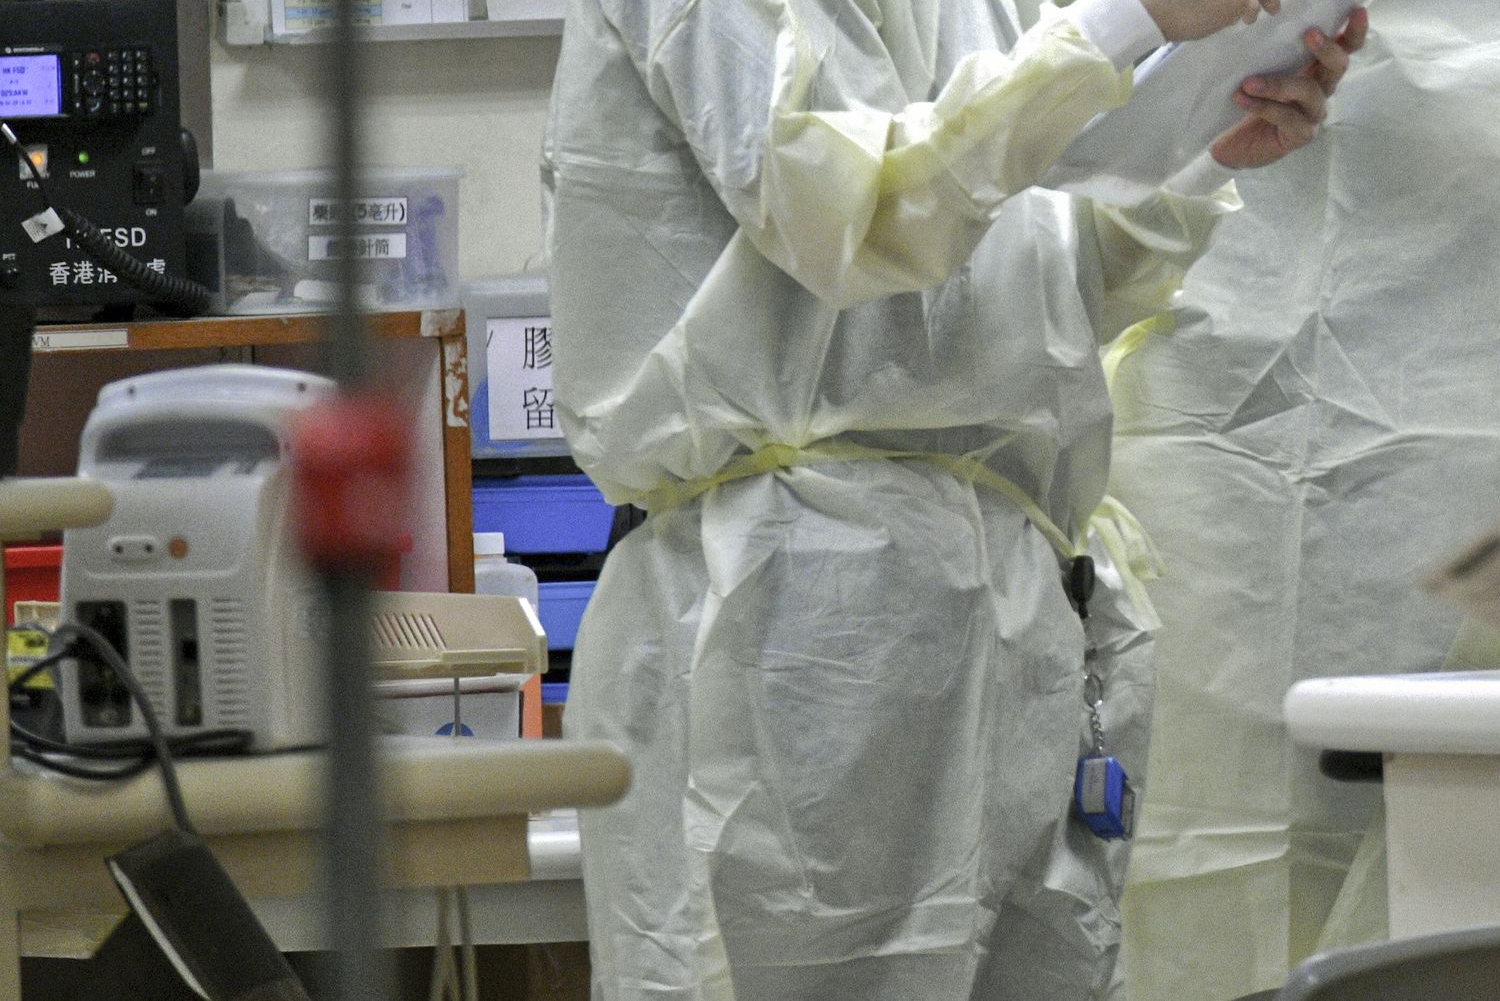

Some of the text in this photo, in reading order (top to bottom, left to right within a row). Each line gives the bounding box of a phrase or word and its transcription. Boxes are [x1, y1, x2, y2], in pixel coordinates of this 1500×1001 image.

[141, 147, 155, 155] OFF
[69, 170, 96, 178] POWER
[145, 208, 157, 216] ON
